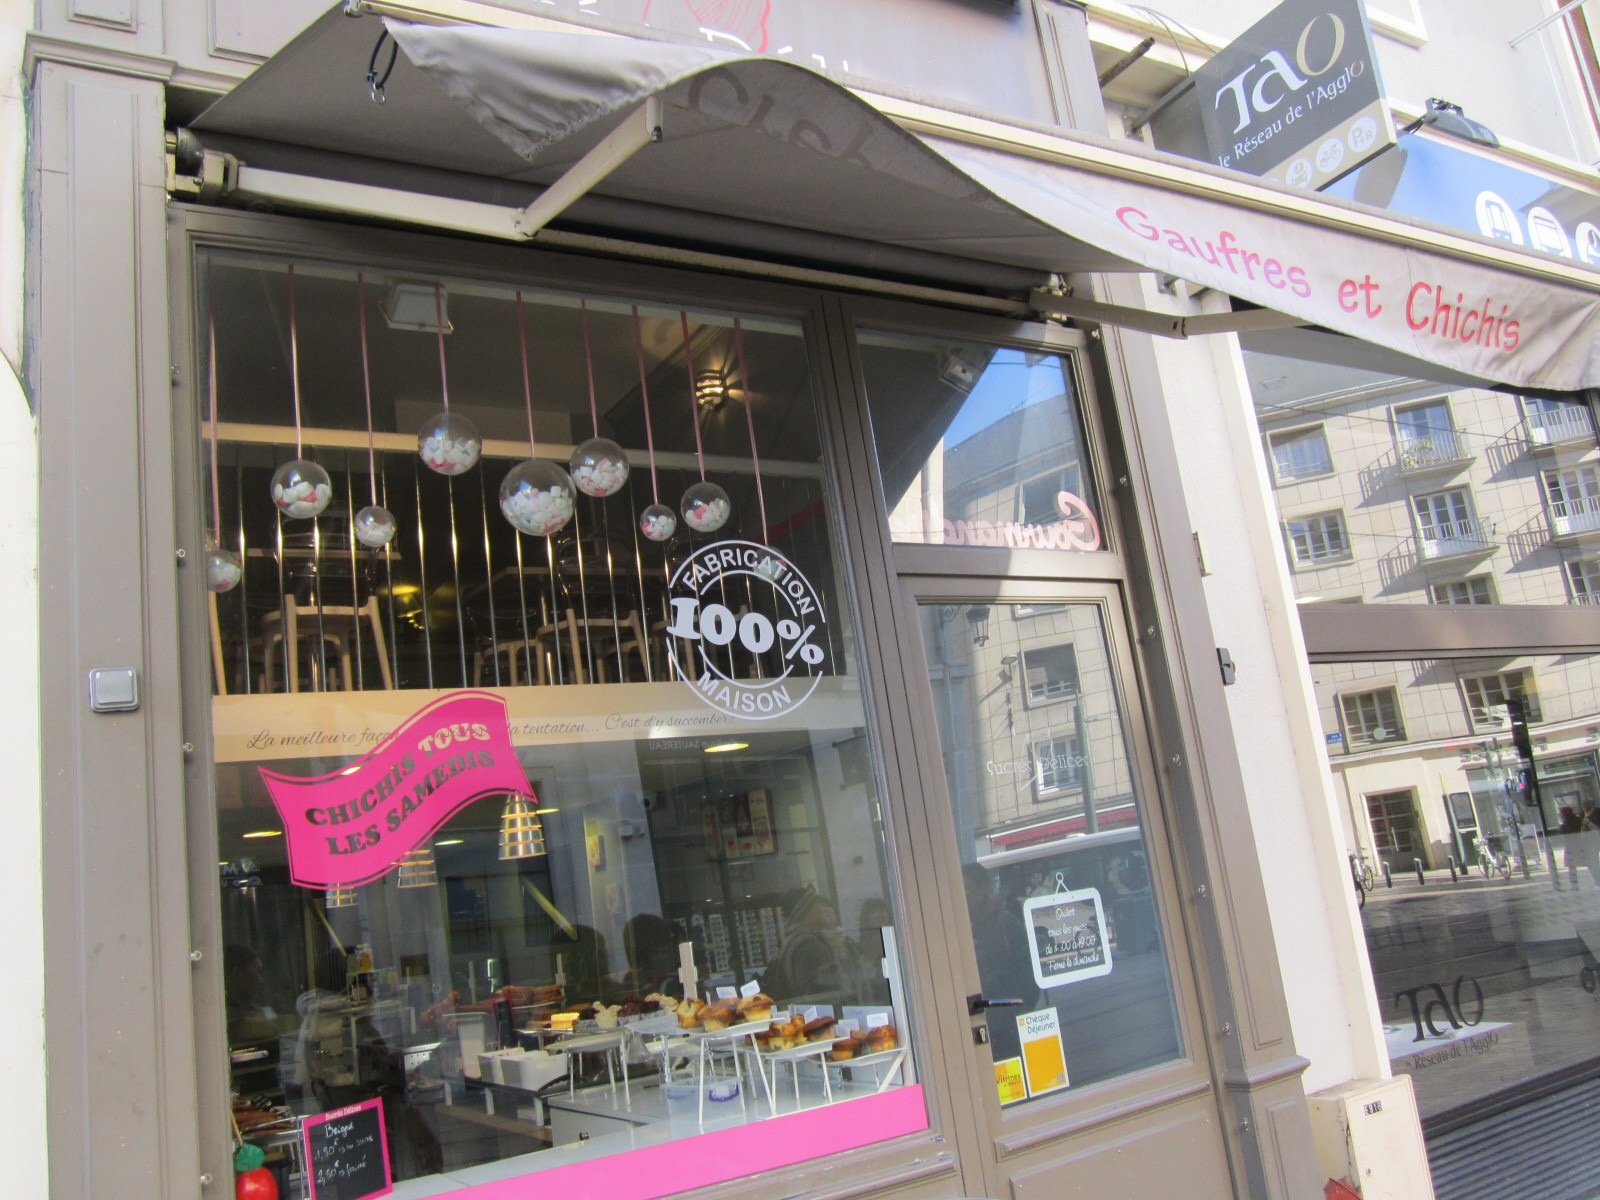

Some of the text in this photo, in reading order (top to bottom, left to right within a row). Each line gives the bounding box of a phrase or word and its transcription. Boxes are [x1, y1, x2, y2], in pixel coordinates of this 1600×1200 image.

[1218, 155, 1231, 168] le
[1234, 119, 1282, 160] Réseau
[1285, 105, 1304, 125] de
[1115, 206, 1521, 353] Gaufres et Chichis
[682, 547, 815, 616] FABRICATION
[666, 597, 825, 665] 100%
[604, 713, 640, 731] C'est
[643, 715, 664, 731] d'y
[696, 671, 792, 713] MAISON
[247, 728, 275, 750] La
[280, 730, 356, 747] meilleure
[304, 722, 491, 826] CHICHIS TOUS
[325, 749, 495, 856] LES SAMEDIS
[1413, 1049, 1448, 1070] Réseau
[1450, 1042, 1463, 1059] de
